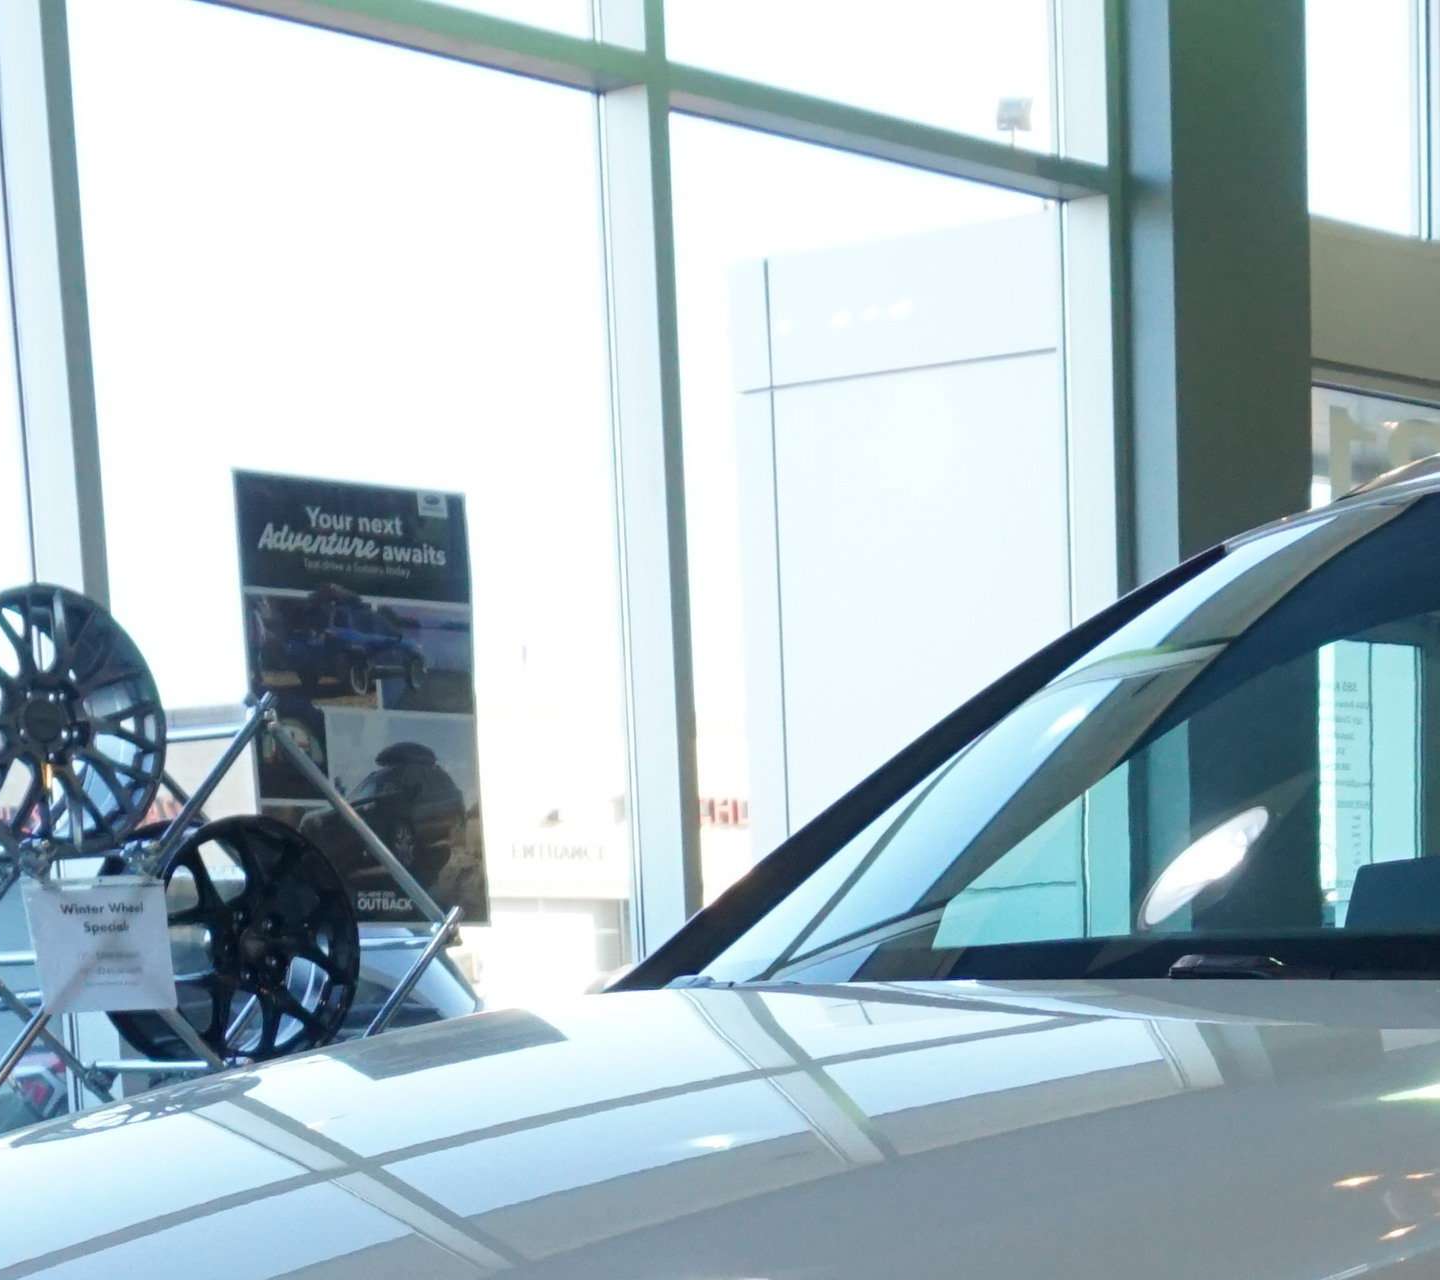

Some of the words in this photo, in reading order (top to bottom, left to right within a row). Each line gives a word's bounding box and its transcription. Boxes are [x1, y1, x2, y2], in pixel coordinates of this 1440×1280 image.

[305, 506, 353, 531] Your
[358, 516, 403, 536] next
[257, 522, 381, 559] Adventure
[382, 543, 447, 566] awaits
[60, 903, 104, 914] Winter
[108, 901, 144, 913] Wheel
[357, 897, 413, 911] OUTBACK
